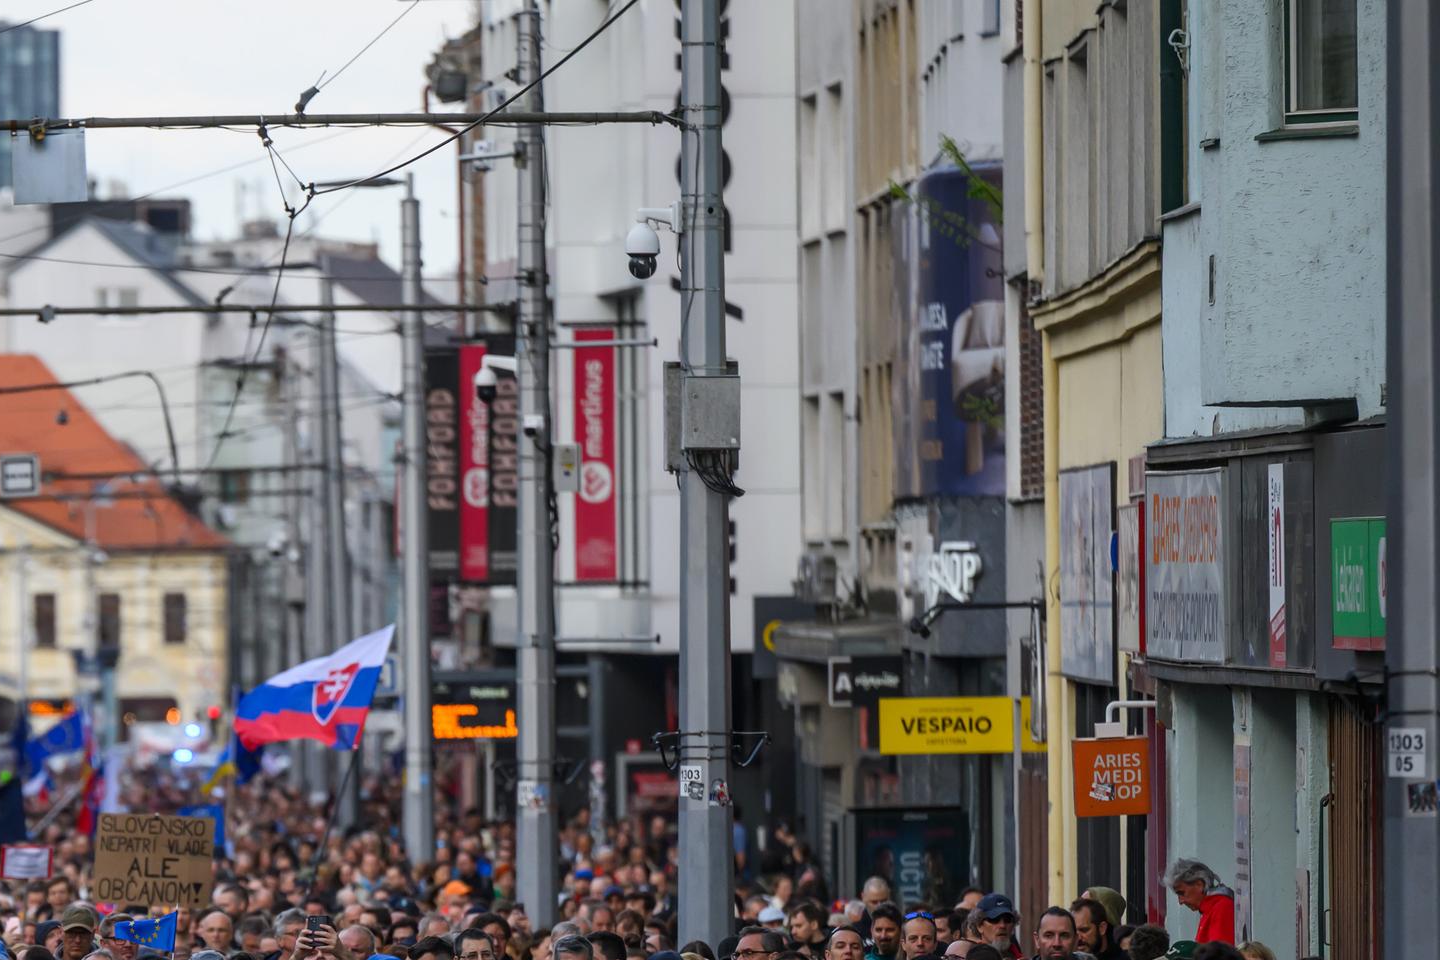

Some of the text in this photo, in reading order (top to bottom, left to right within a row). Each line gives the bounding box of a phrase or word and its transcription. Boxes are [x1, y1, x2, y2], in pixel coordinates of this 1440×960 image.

[580, 359, 604, 459] martinus
[900, 715, 993, 736] VESPAIO
[1390, 734, 1424, 750] 1303
[1093, 752, 1142, 769] ARIES
[1396, 756, 1414, 772] 05
[1093, 768, 1142, 784] MEDI
[1113, 784, 1142, 800] OP
[101, 816, 206, 837] SLOVENSKO
[127, 857, 180, 879] ALE
[98, 877, 204, 905] OBČANOM!
